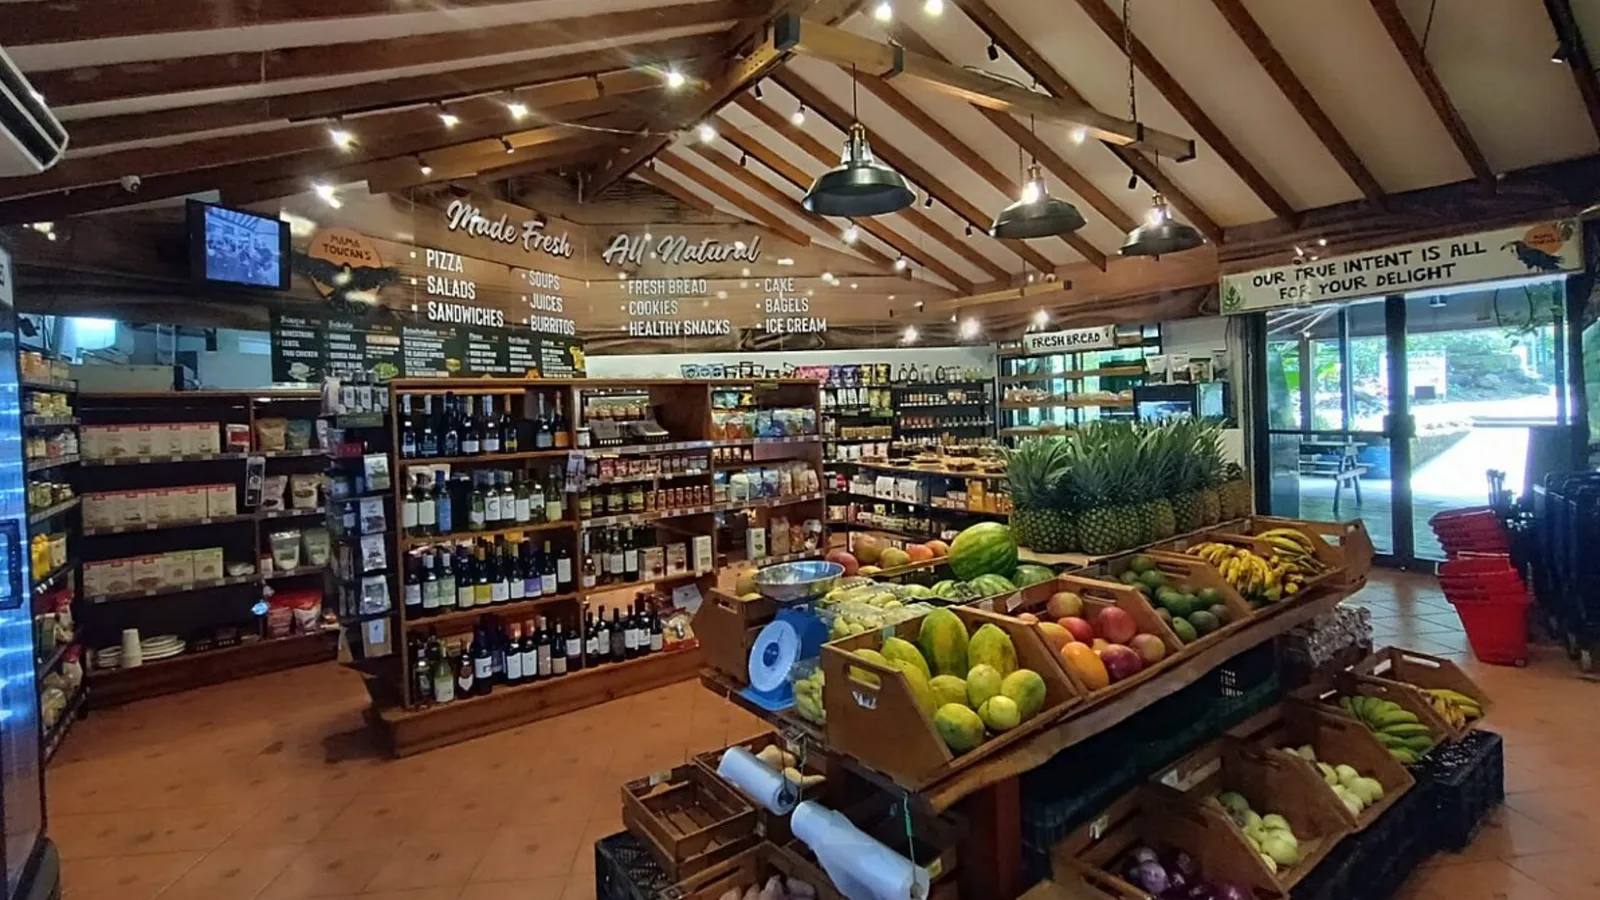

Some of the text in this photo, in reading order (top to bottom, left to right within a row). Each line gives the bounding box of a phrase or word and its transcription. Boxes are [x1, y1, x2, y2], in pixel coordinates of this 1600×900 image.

[447, 200, 574, 259] Made Fresh
[331, 234, 360, 248] MAMA
[602, 233, 761, 265] All Natural
[426, 249, 464, 273] PIZZA
[1253, 241, 1487, 287] OUR TRUE INTENT IS ALL
[427, 276, 476, 300] SALADS
[529, 270, 561, 290] SOUPS
[628, 278, 707, 295] FRESH BREAD
[764, 278, 795, 292] CAKE
[1279, 263, 1456, 300] FOR YOUR DELIGHT
[529, 293, 563, 313] JUICES
[628, 300, 678, 315] COOKIES
[765, 298, 809, 313] BAGELS
[427, 303, 504, 328] SANDWICHES
[766, 317, 827, 333] ICE CREAM
[530, 317, 576, 336] BURRITOS
[629, 318, 730, 336] HEALTHY SNACKS
[1032, 332, 1100, 348] FRESH BREAD
